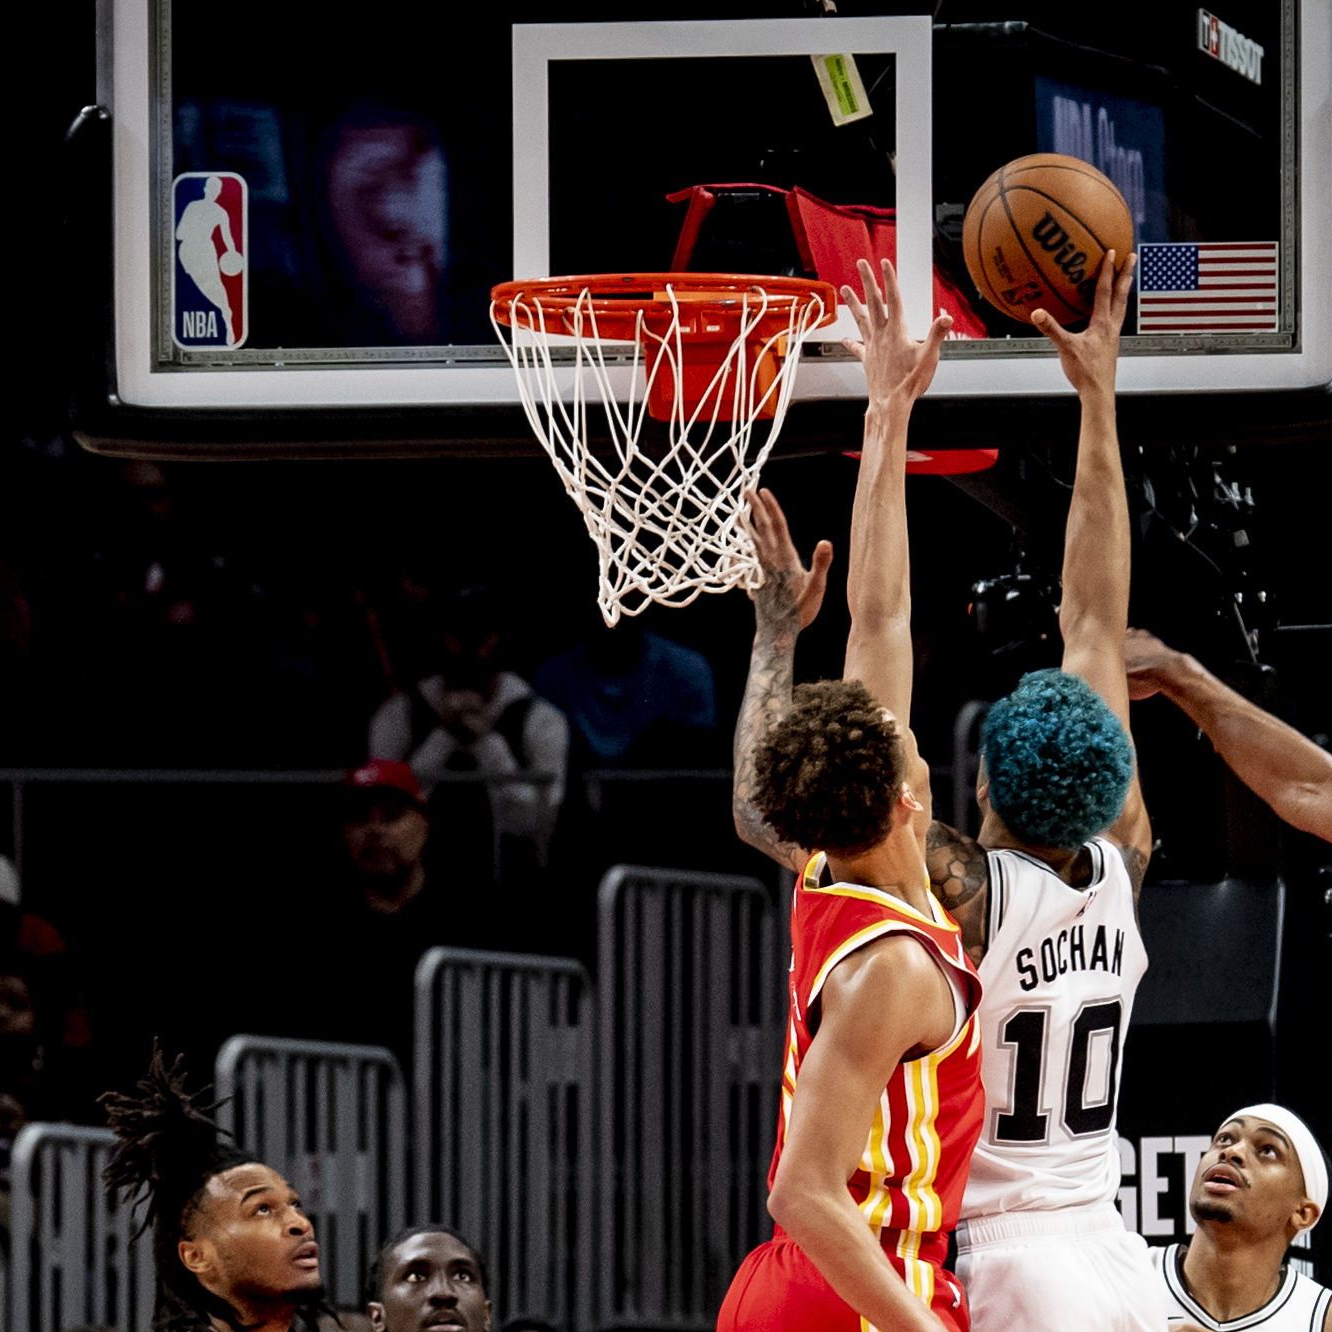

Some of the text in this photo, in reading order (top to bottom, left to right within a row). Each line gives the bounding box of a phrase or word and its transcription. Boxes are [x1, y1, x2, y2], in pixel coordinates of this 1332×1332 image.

[1218, 20, 1264, 86] TISSOT
[1032, 210, 1096, 307] Wilso
[182, 310, 218, 338] NBA
[1016, 924, 1125, 992] SOCHAN
[988, 994, 1123, 1147] 10
